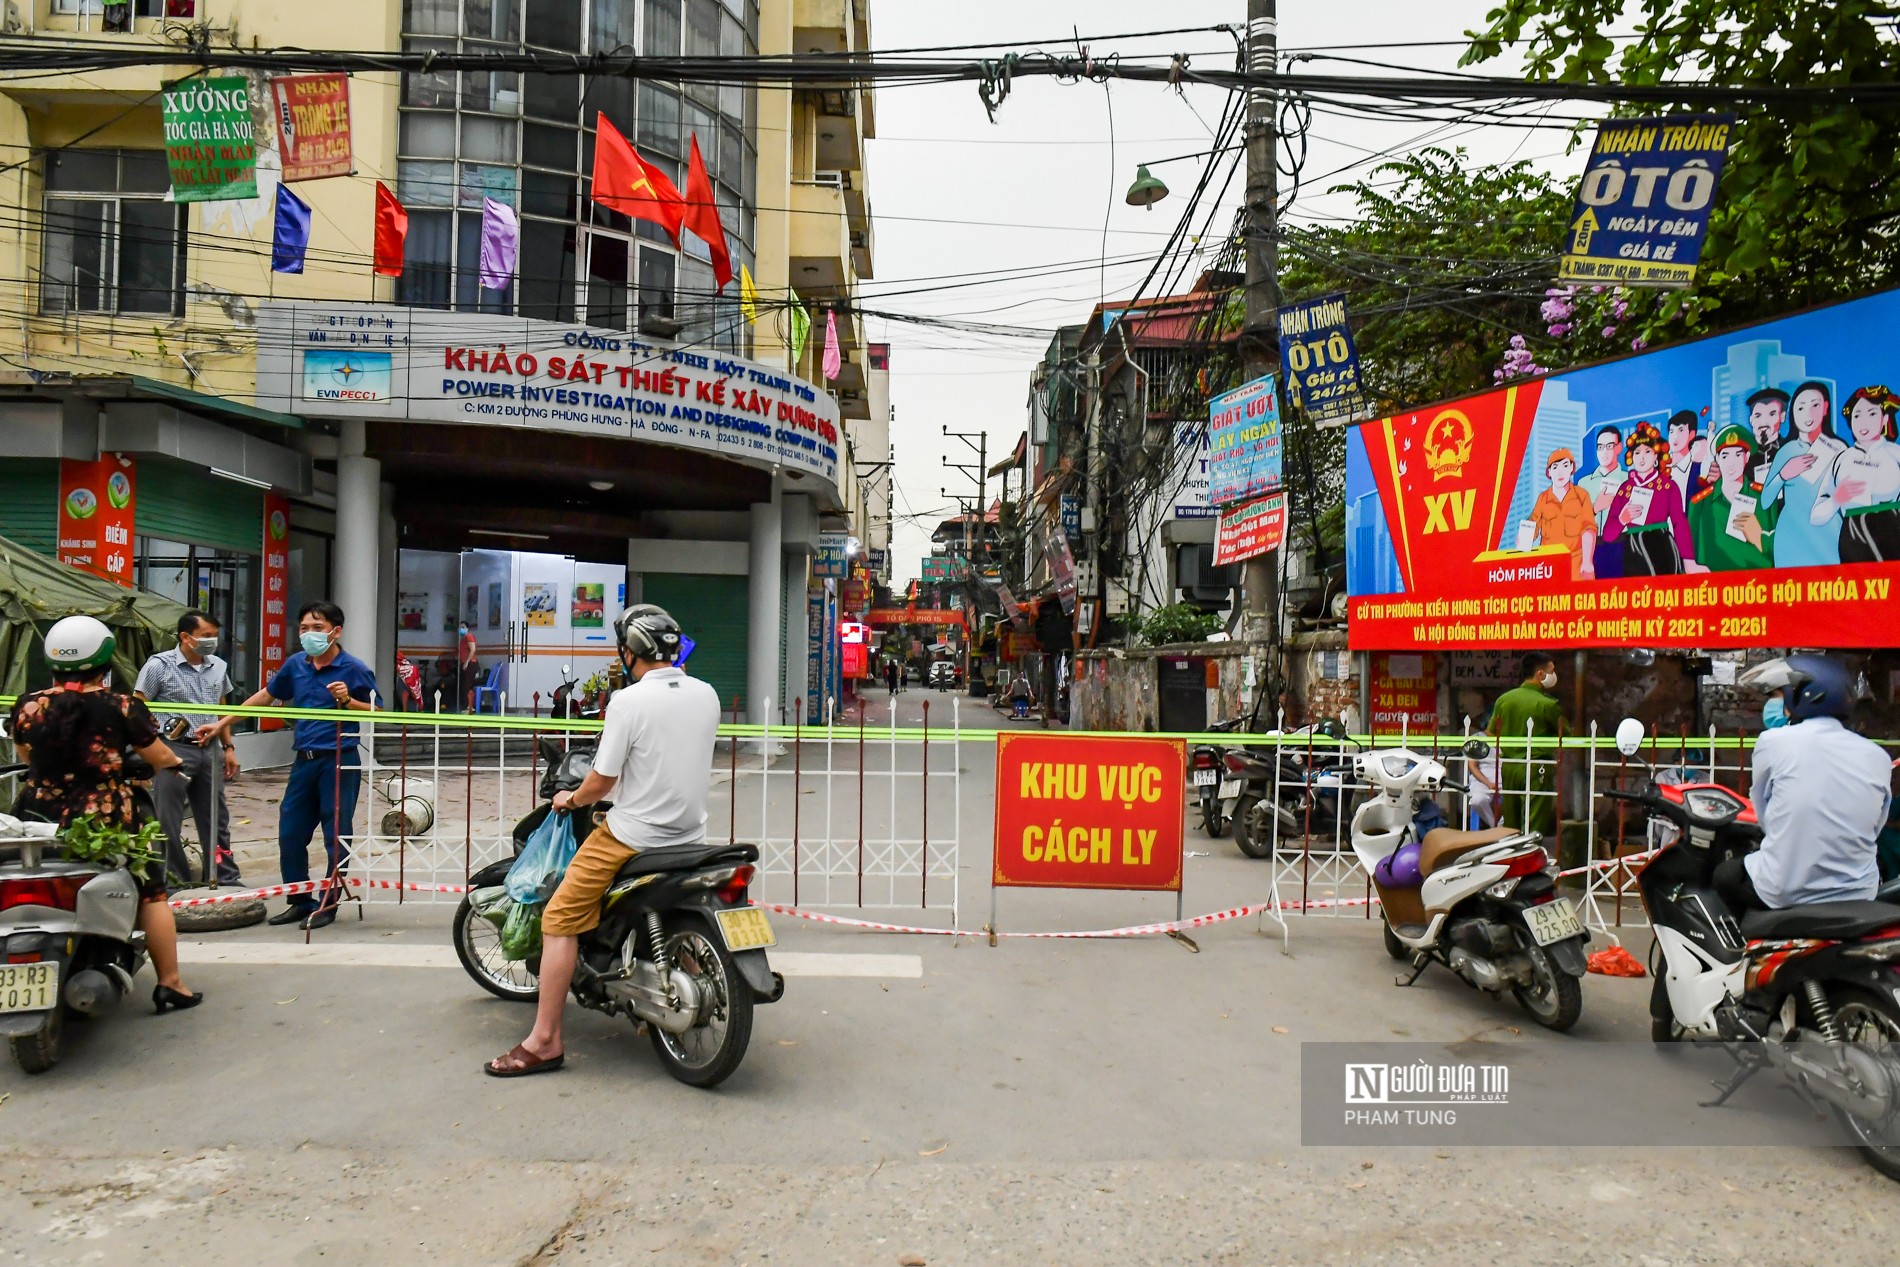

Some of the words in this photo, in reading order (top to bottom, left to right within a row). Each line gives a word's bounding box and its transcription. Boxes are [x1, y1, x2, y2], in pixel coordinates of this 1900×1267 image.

[164, 81, 248, 113] XƯỞNG
[295, 80, 340, 96] NHẬN
[165, 116, 187, 140] TÓC
[190, 113, 210, 140] GIẢ
[214, 115, 230, 139] HÀ
[232, 115, 253, 145] NỘI
[293, 98, 332, 136] TRÔNG
[334, 101, 348, 132] XE
[1596, 124, 1658, 158] NHẬN
[1659, 120, 1729, 152] TRÔNG
[169, 141, 214, 165] NHẬN
[221, 146, 253, 160] MAY
[224, 167, 254, 183] NGAY
[1579, 159, 1715, 211] ÔTÔ
[1577, 219, 1592, 248] 20m
[1659, 217, 1698, 236] ĐÊM
[1619, 240, 1650, 258] GIÁ
[1652, 241, 1677, 261] RẺ
[1280, 306, 1309, 338] NHẬN
[1310, 299, 1346, 330] TRÔNG
[564, 331, 621, 351] CÔNG
[628, 342, 650, 358] TY
[659, 349, 709, 370] TNHH
[714, 359, 745, 378] MỘT
[748, 369, 791, 393] THANH
[1288, 331, 1349, 371] ÔTÔ
[444, 343, 538, 376] KHẢO
[547, 354, 607, 385] SÁT
[615, 365, 690, 398] THIẾT
[696, 377, 728, 406] KẾ
[732, 388, 773, 416] XÂY
[777, 401, 816, 432] DỰNG
[1306, 370, 1335, 387] Giá
[1340, 364, 1355, 380] rẻ
[1310, 381, 1358, 401] 24/24
[443, 378, 515, 400] POWER
[520, 386, 667, 416] INVESTIGATION
[671, 405, 702, 422] AND
[705, 411, 772, 438] DESIGNING
[478, 403, 494, 415] KM
[497, 405, 502, 415] 2
[506, 404, 547, 418] ĐƯỜNG
[552, 408, 588, 422] PHÙNG
[592, 414, 622, 426] HƯNG
[631, 417, 645, 429] HÀ
[1213, 406, 1242, 431] GIẶT
[1246, 393, 1274, 418] ƯỚT
[1240, 419, 1277, 443] NGAY
[1260, 513, 1280, 527] May
[1422, 488, 1476, 535] XV
[106, 521, 127, 545] ĐIỂM
[107, 554, 124, 572] CẤP
[268, 551, 284, 568] ĐIỂM
[1488, 567, 1515, 583] HÒM
[1518, 561, 1553, 582] PHIẾU
[269, 573, 282, 591] CẤP
[1357, 602, 1369, 620] CỬ
[1370, 606, 1384, 619] TRI
[1386, 598, 1423, 619] PHƯỜNG
[1426, 597, 1449, 616] KIẾN
[1452, 600, 1480, 616] HƯNG
[1483, 595, 1507, 615] TÍCH
[1510, 598, 1534, 618] CỰC
[1537, 594, 1571, 612] THAM
[1574, 592, 1596, 610] GIA
[1600, 585, 1628, 610] BẦU
[1631, 585, 1652, 609] CỬ
[1654, 589, 1679, 613] ĐẠI
[1683, 580, 1718, 607] BIỂU
[1722, 578, 1767, 605] QUỐC
[1772, 579, 1802, 607] HỘI
[1807, 576, 1859, 602] KHÓA
[1864, 578, 1890, 600] XV
[269, 624, 280, 637] ION
[1413, 623, 1426, 642] VÀ
[1428, 625, 1445, 644] HỘI
[1447, 621, 1476, 641] ĐỒNG
[1479, 622, 1510, 640] NHÂN
[1513, 621, 1537, 639] DÂN
[1540, 620, 1564, 639] CÁC
[1567, 615, 1593, 638] CẤP
[1597, 618, 1641, 641] NHIỆM
[1645, 615, 1665, 637] KỲ
[1668, 619, 1703, 637] 2021
[1720, 617, 1767, 637] 2026!
[1020, 762, 1087, 800] KHU
[1098, 762, 1162, 810] VỰC
[1022, 818, 1111, 864] CÁCH
[1122, 829, 1157, 865] LY
[1536, 917, 1580, 942] 225.80
[0, 988, 46, 1009] 031
